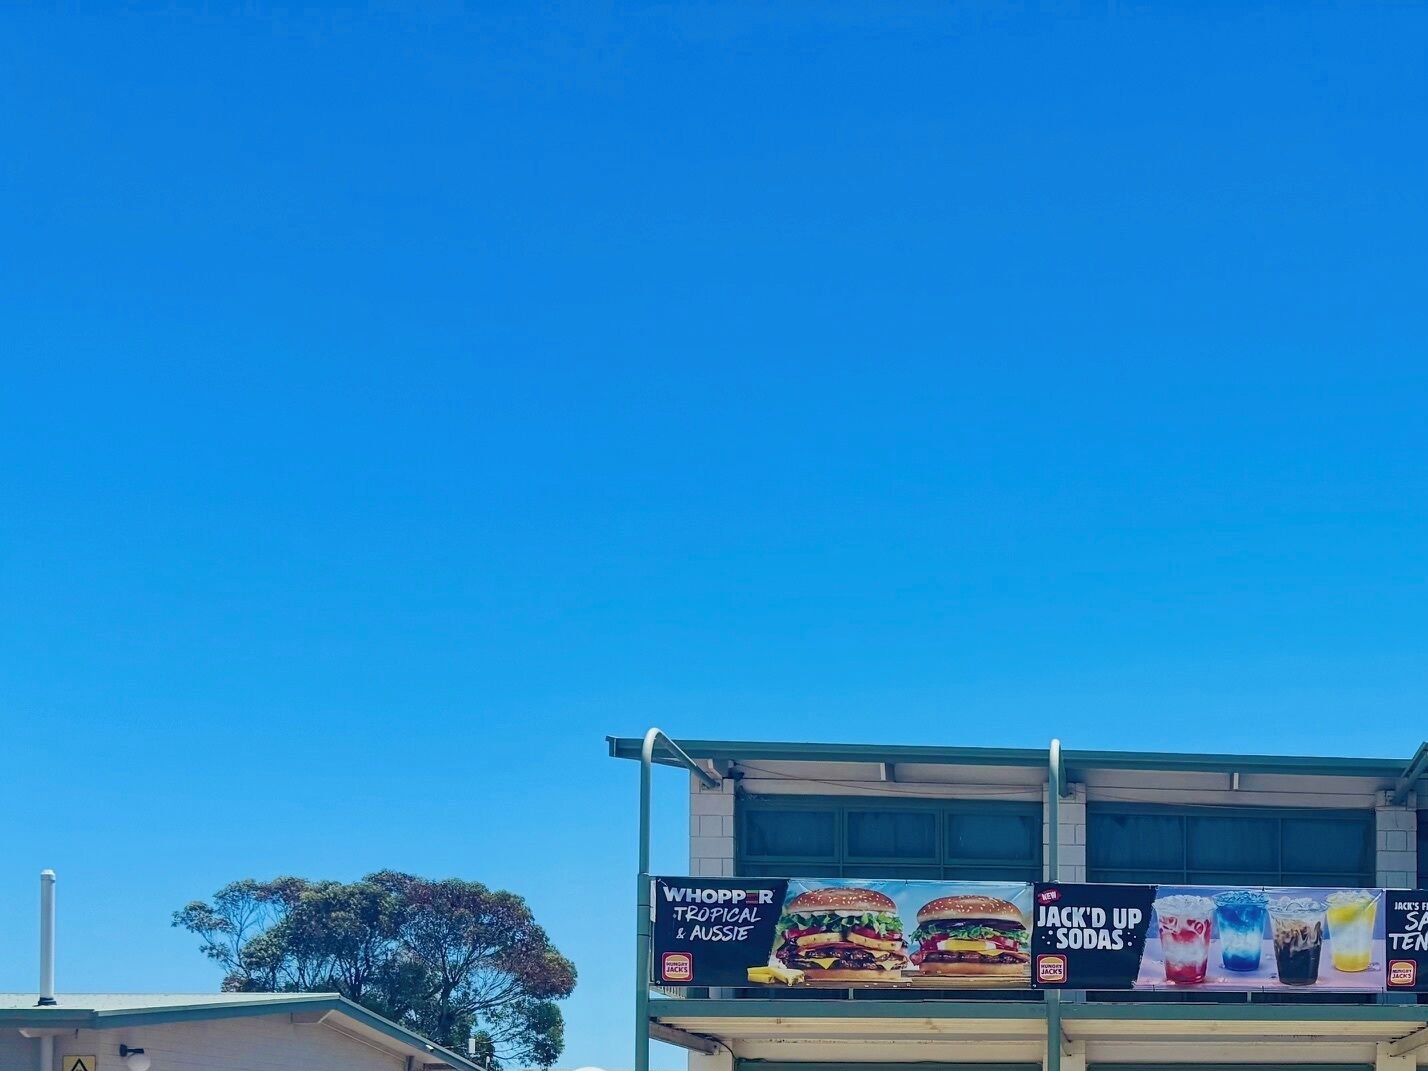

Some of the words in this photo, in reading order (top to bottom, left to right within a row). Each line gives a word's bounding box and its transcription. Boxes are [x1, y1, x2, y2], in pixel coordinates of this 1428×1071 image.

[1041, 891, 1057, 901] NEW
[673, 905, 762, 922] TROPICAL
[1394, 901, 1420, 911] JACK'S
[1037, 906, 1106, 928] JACK'D
[1113, 908, 1143, 929] UP
[676, 927, 687, 939] &
[689, 924, 755, 941] AUSSIE
[1056, 927, 1124, 950] SODAS
